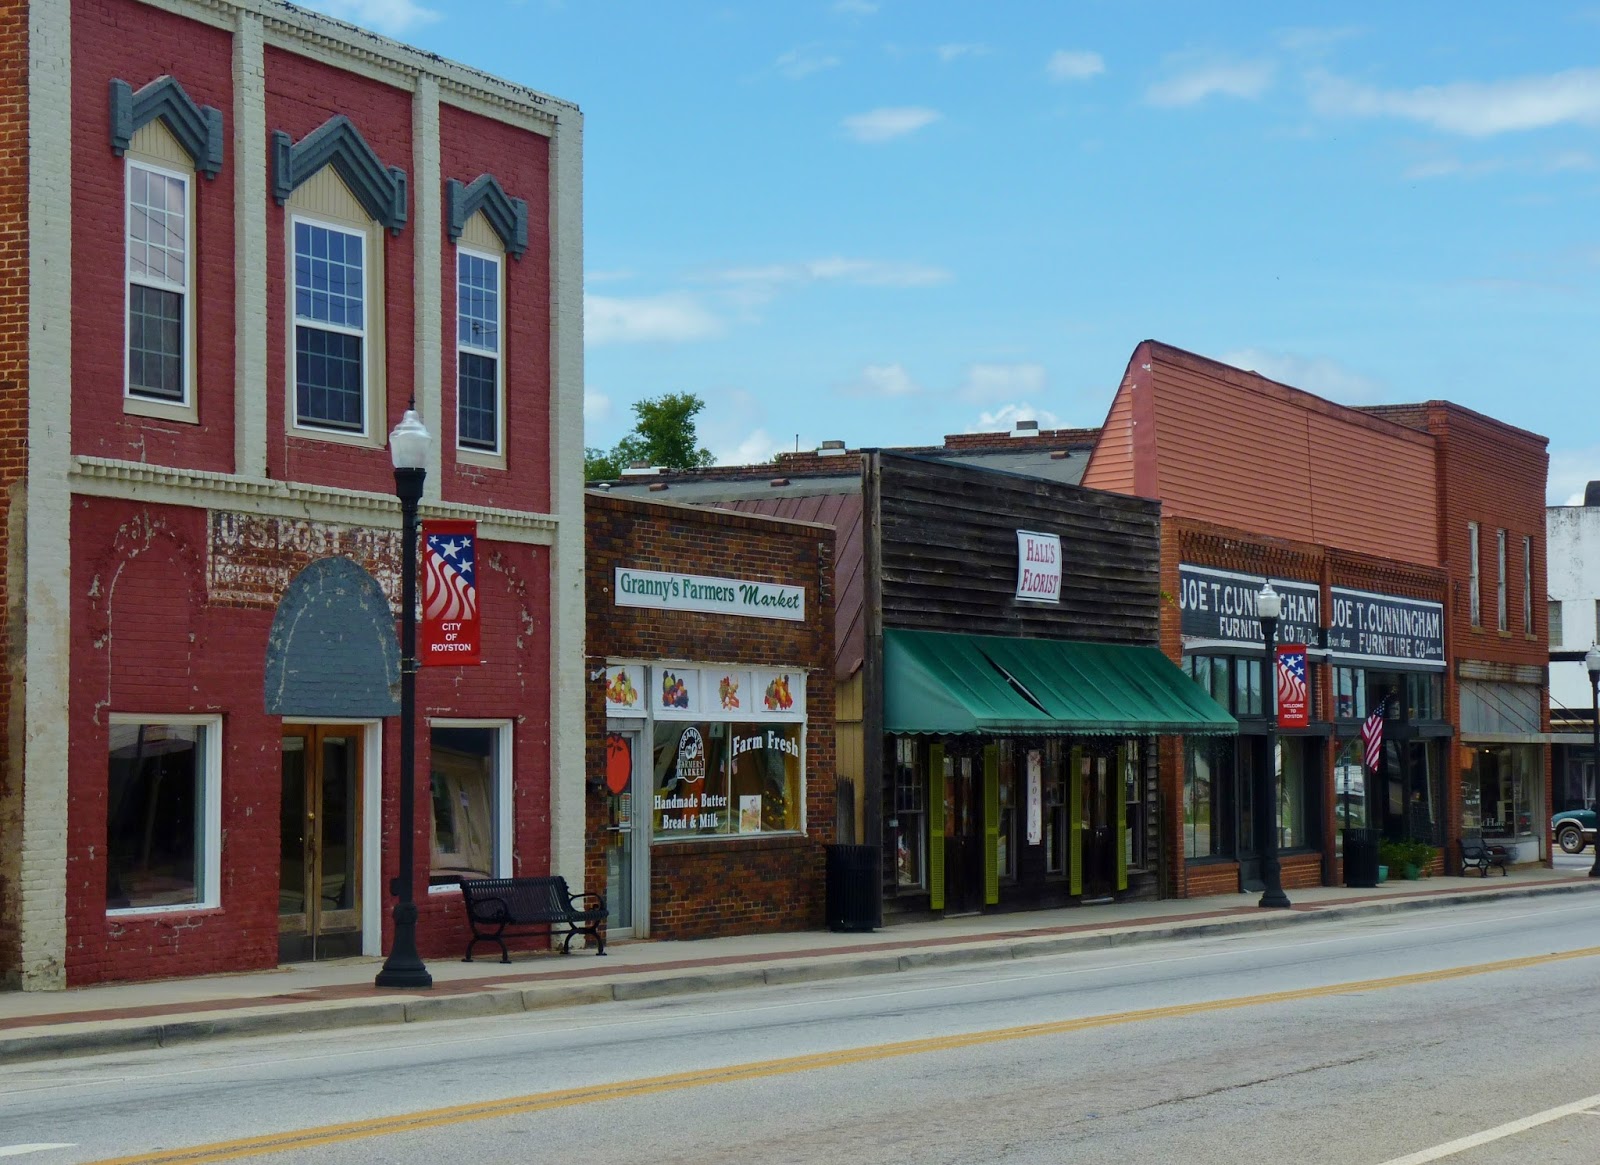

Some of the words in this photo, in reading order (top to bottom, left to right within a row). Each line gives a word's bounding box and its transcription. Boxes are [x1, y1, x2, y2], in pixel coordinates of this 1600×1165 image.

[1026, 538, 1055, 564] HALL'S
[620, 572, 679, 602] Granny's
[682, 578, 735, 603] Farmers
[739, 584, 800, 609] Market
[1021, 568, 1059, 594] FLORIST
[1180, 578, 1208, 611] JOE
[1224, 585, 1317, 624] CUNNGHAM
[441, 622, 462, 631] CITY
[1331, 598, 1353, 629] JOE
[1368, 603, 1440, 639] CUNNINGHAM
[445, 633, 458, 641] OF
[1284, 624, 1295, 642] CO
[1358, 633, 1412, 657] FURNITURE
[1414, 639, 1426, 658] CO
[431, 643, 472, 652] ROYSTON
[732, 735, 763, 757] Farm
[767, 730, 799, 758] Fresh
[654, 793, 698, 810] Handmade
[701, 792, 727, 808] Butter
[663, 813, 687, 829] Bread
[689, 814, 697, 829] &
[699, 812, 719, 828] Milk
